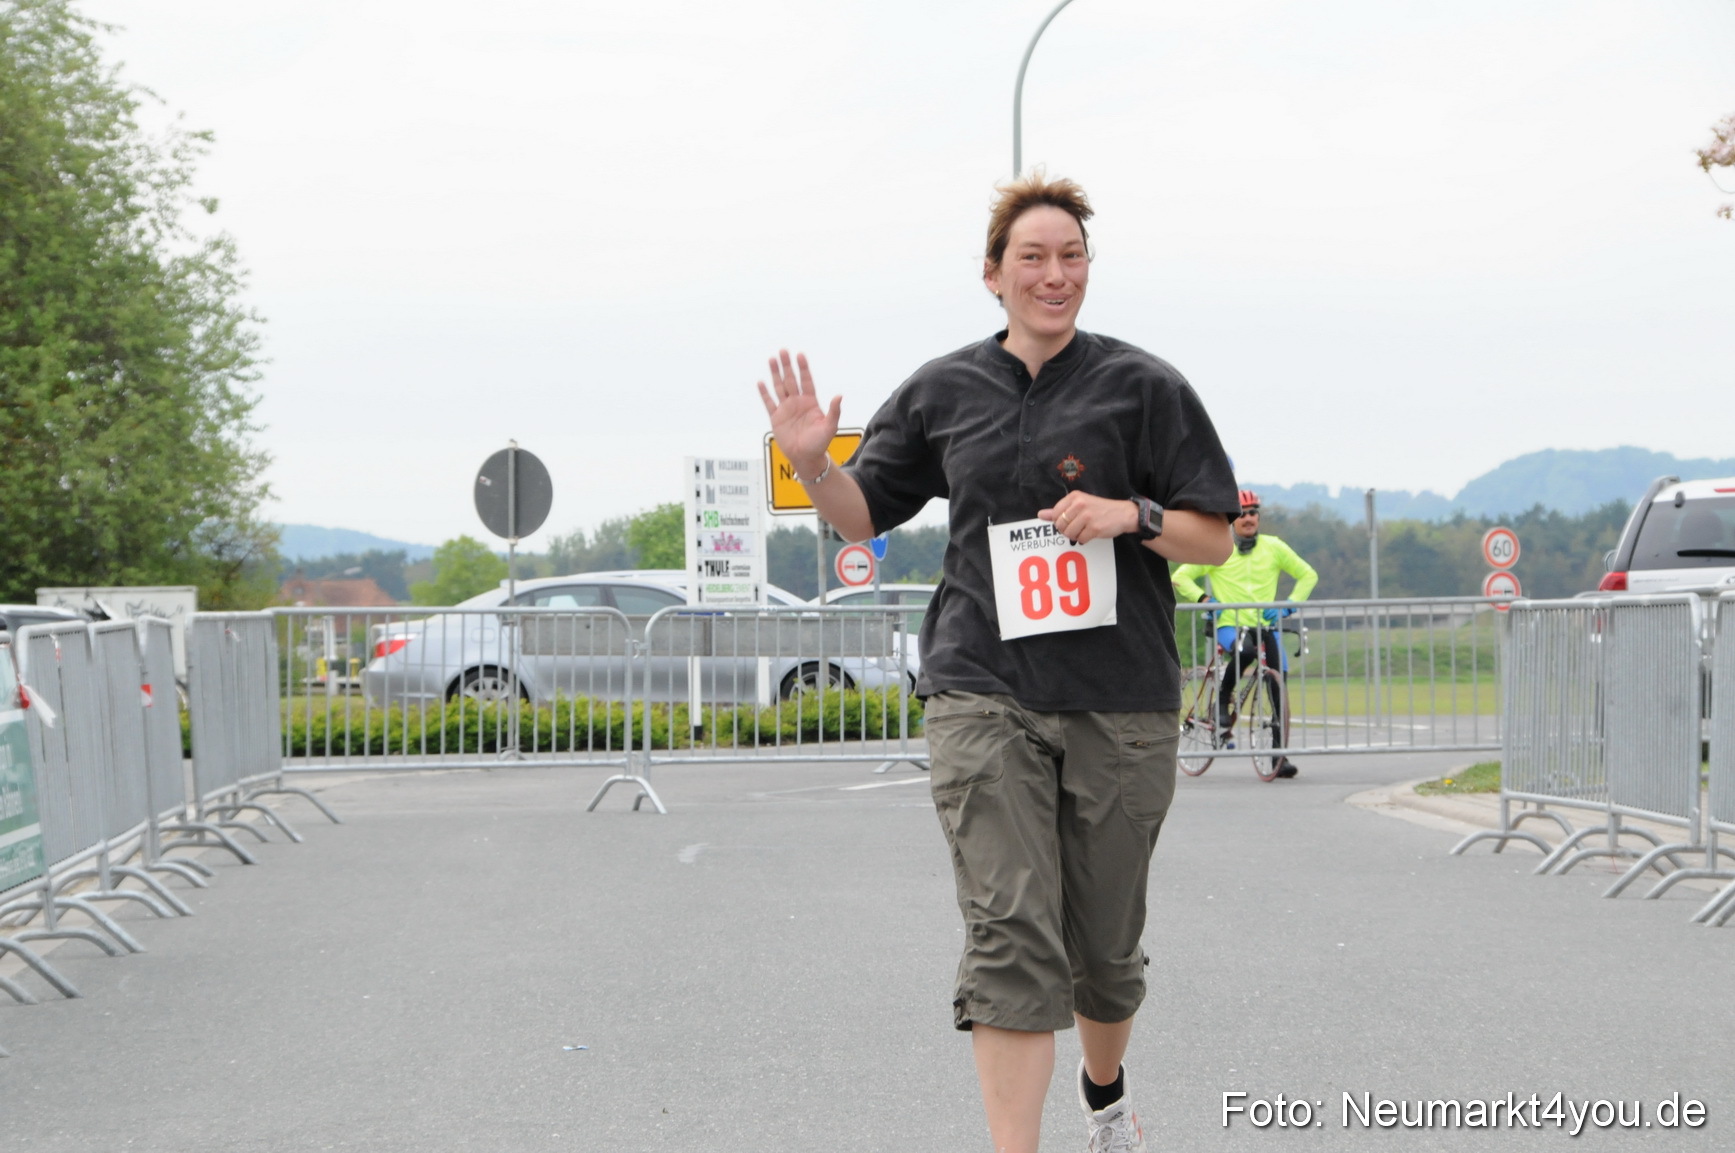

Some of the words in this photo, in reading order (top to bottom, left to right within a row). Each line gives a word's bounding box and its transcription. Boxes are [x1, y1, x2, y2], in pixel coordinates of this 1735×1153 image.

[1011, 537, 1065, 551] WERBUNG
[1493, 540, 1511, 557] 60
[704, 560, 729, 577] THULE
[1019, 551, 1091, 620] 89
